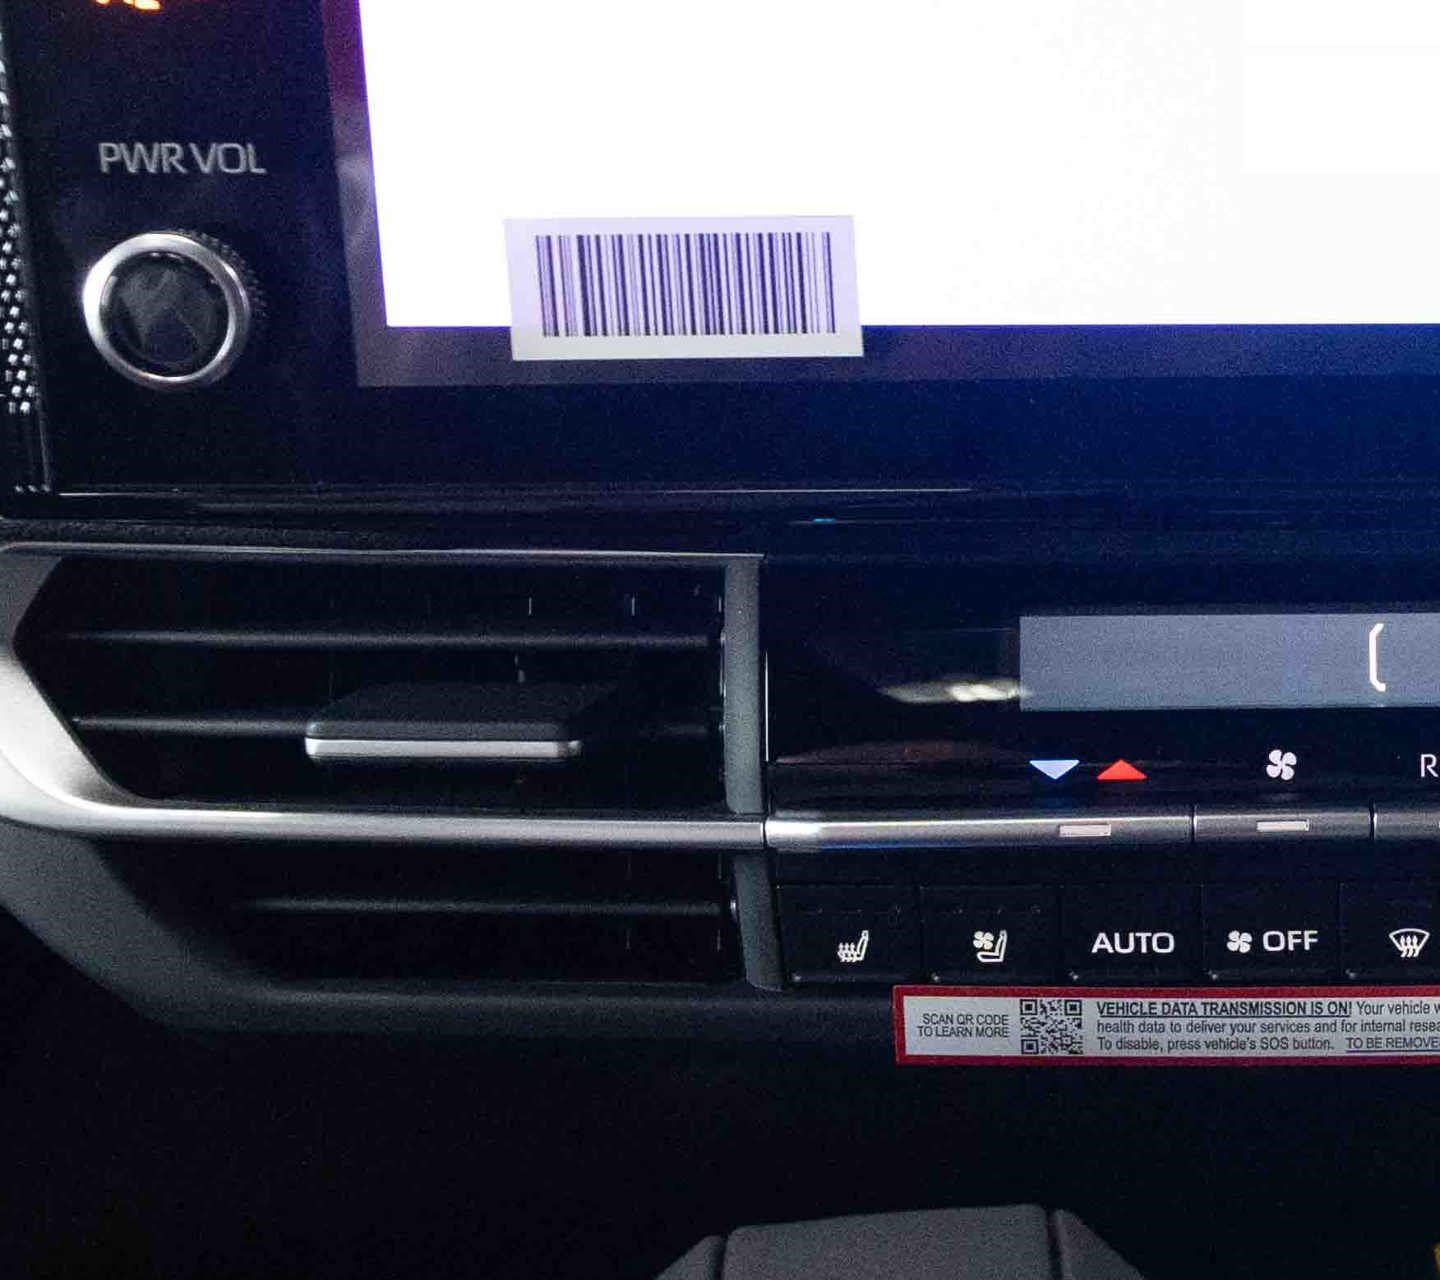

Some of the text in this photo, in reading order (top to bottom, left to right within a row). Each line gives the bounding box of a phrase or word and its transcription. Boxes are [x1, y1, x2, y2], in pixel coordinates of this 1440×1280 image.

[99, 142, 266, 174] PWR VOL
[1091, 930, 1175, 957] AUTO
[1261, 927, 1319, 954] OFF
[1096, 1001, 1157, 1016] VEHICLE
[1161, 1001, 1198, 1015] DATA
[1201, 1001, 1306, 1015] TRANSMISSION
[1310, 1001, 1323, 1015] IS
[1327, 1001, 1352, 1015] ON!
[1356, 1000, 1384, 1015] Your
[1388, 1000, 1430, 1015] vehicle
[922, 1013, 1009, 1026] SCAN QR CODE
[1096, 1019, 1135, 1033] health
[1138, 1020, 1165, 1033] data
[1169, 1020, 1182, 1033] to
[1186, 1019, 1226, 1033] deliver
[1229, 1022, 1256, 1036] your
[1260, 1020, 1310, 1033] services
[1314, 1019, 1337, 1033] and
[1341, 1019, 1356, 1032] for
[1361, 1019, 1406, 1032] internal
[917, 1025, 1010, 1038] TO LEARN MORE
[1097, 1036, 1112, 1051] To
[1116, 1036, 1164, 1053] disable,
[1167, 1038, 1200, 1052] press
[1204, 1036, 1256, 1051] vehicle's
[1260, 1036, 1289, 1050] SOS
[1292, 1036, 1335, 1051] button.
[1346, 1037, 1363, 1049] TO
[1366, 1037, 1383, 1049] BE
